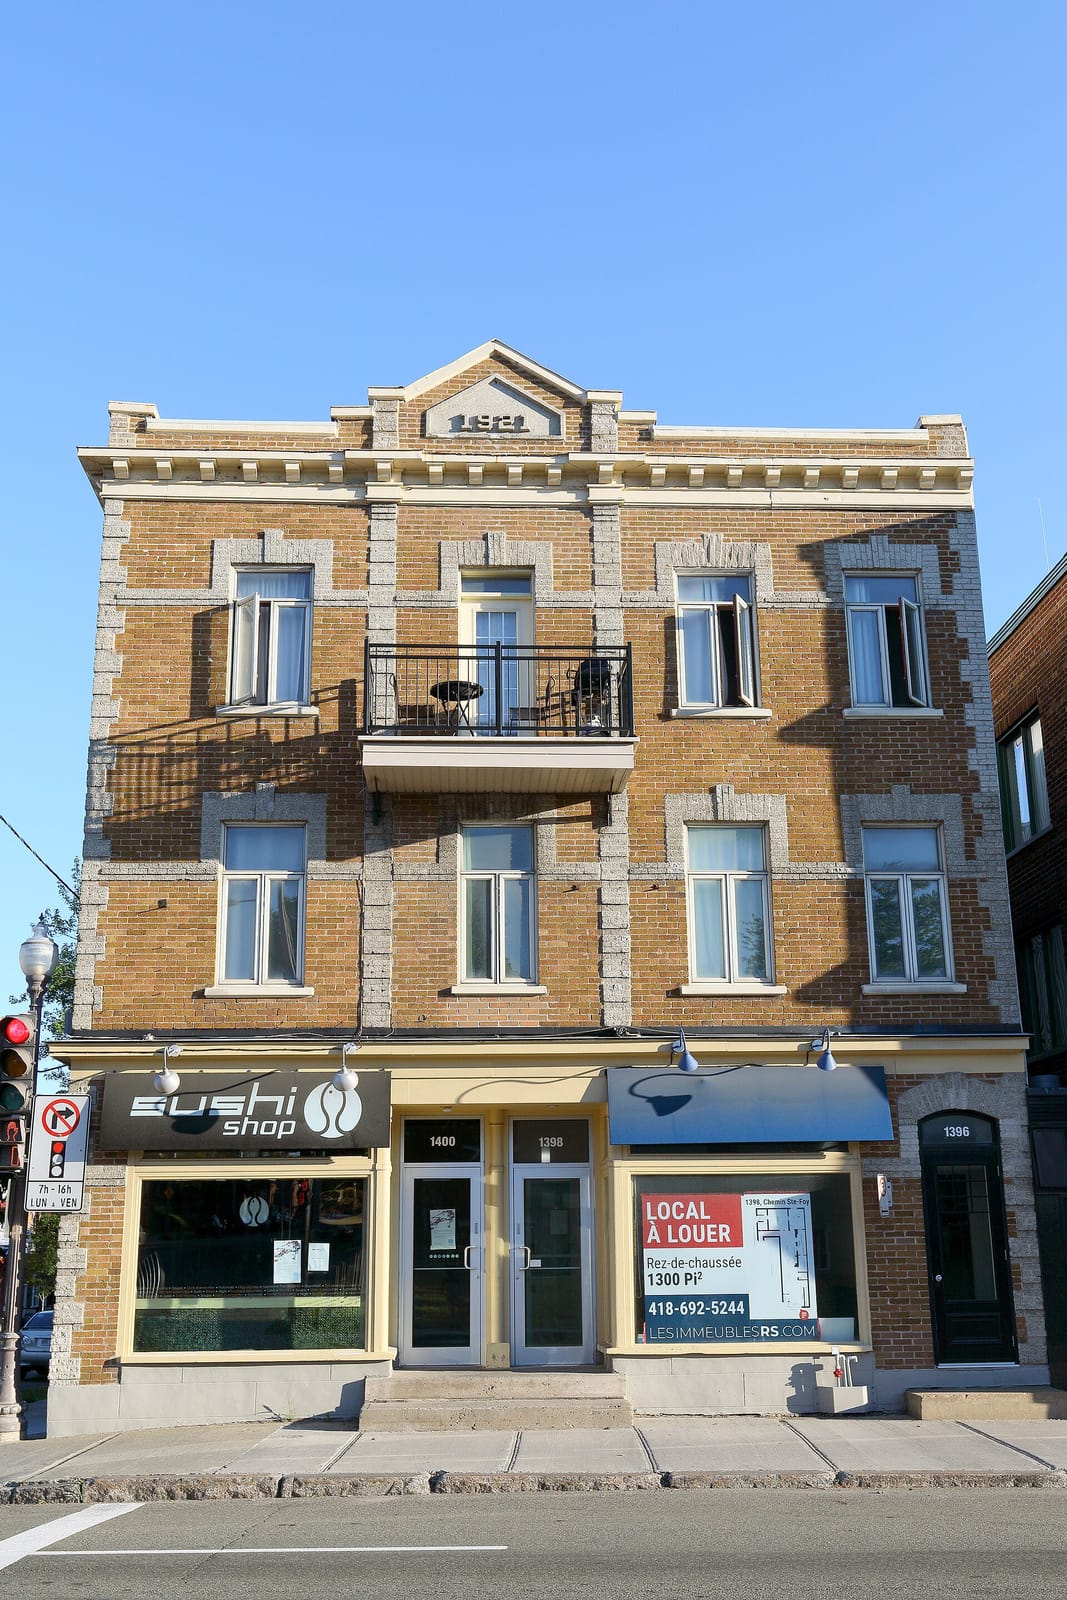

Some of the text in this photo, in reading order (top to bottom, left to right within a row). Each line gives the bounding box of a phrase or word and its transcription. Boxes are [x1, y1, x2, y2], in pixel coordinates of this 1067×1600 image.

[129, 1082, 298, 1117] sushi
[222, 1116, 297, 1139] shop
[943, 1126, 970, 1137] 1396
[429, 1136, 456, 1147] 1400
[538, 1137, 563, 1148] 1398
[38, 1184, 49, 1194] 7h
[57, 1184, 72, 1194] 16h
[30, 1198, 47, 1207] LUN
[60, 1198, 77, 1207] VEN
[763, 1198, 786, 1206] Chemin
[646, 1201, 711, 1220] LOCAL
[647, 1221, 731, 1243] À LOUER
[647, 1256, 742, 1269] Rez-de-chaussée
[647, 1272, 680, 1286] 1300
[649, 1300, 745, 1316] 418-692-5244
[650, 1325, 816, 1340] LESIMMEUBLESRS.COM
